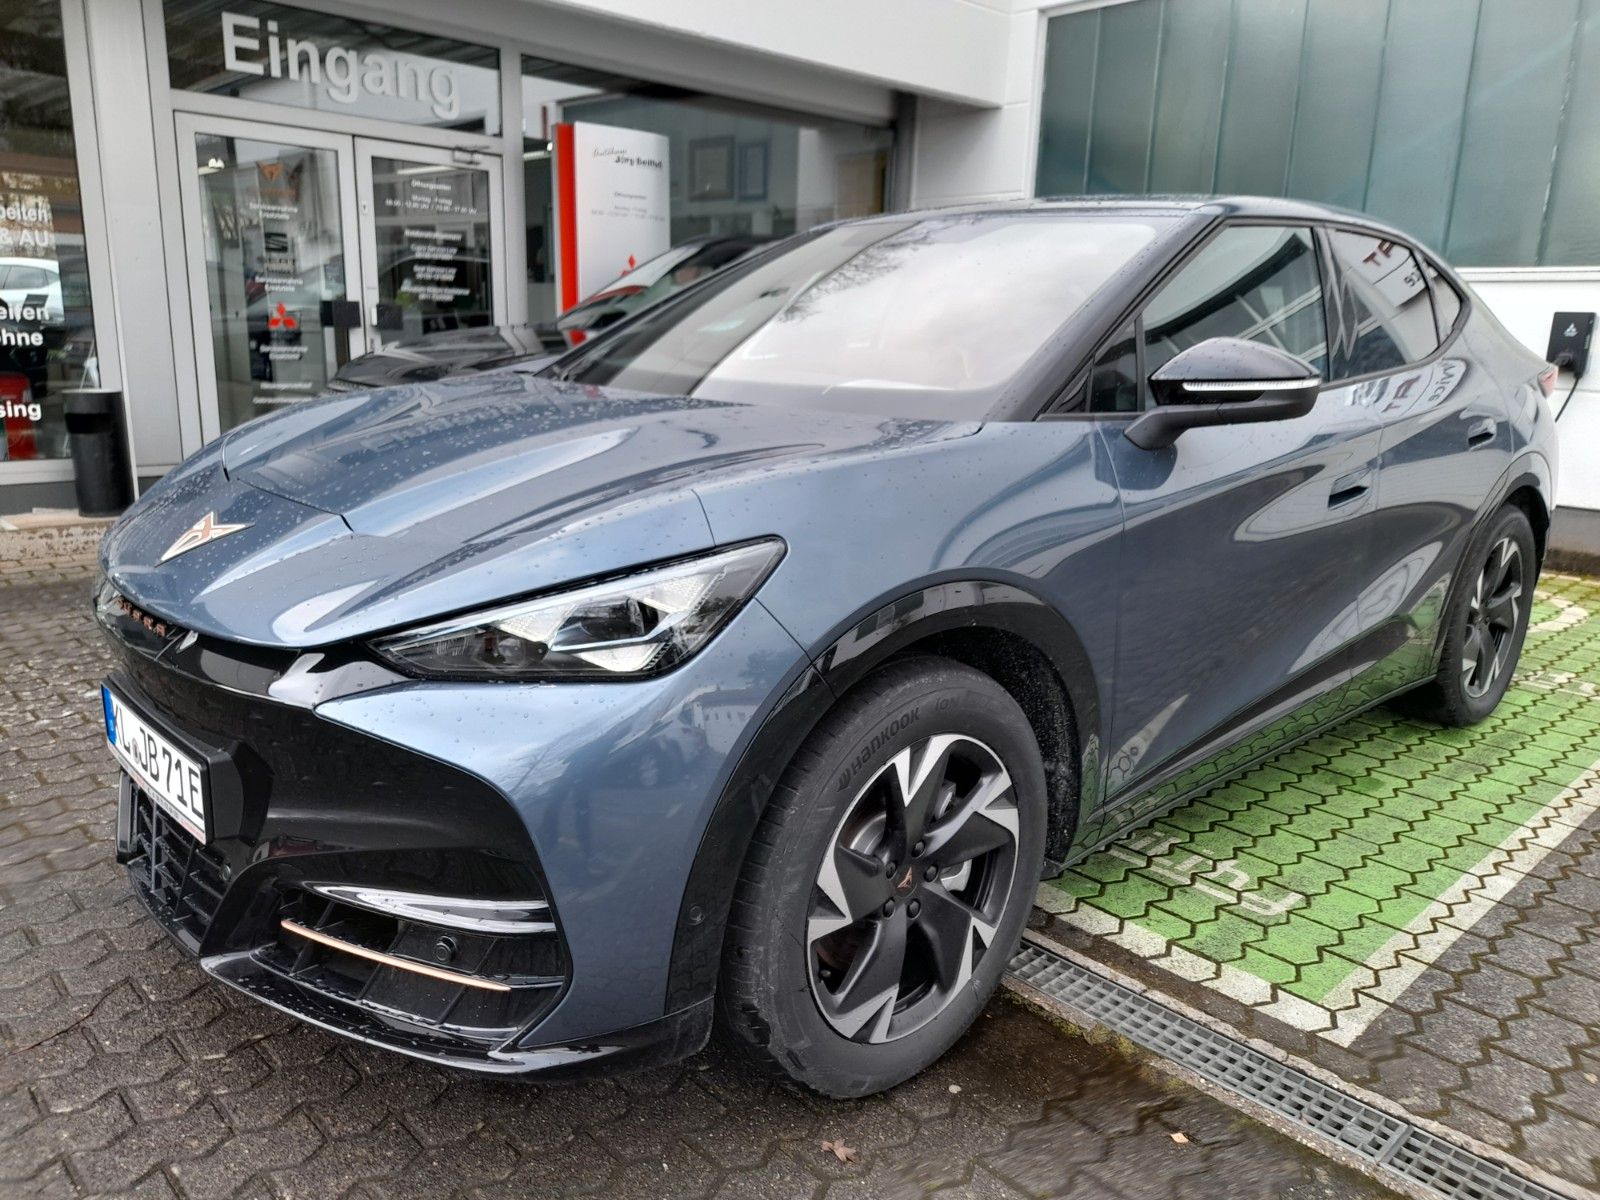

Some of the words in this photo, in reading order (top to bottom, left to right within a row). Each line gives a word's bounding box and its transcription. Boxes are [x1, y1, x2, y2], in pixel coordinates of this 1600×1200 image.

[221, 11, 460, 120] Eingang
[19, 228, 49, 248] AU
[0, 328, 44, 346] hne
[0, 400, 42, 421] sing
